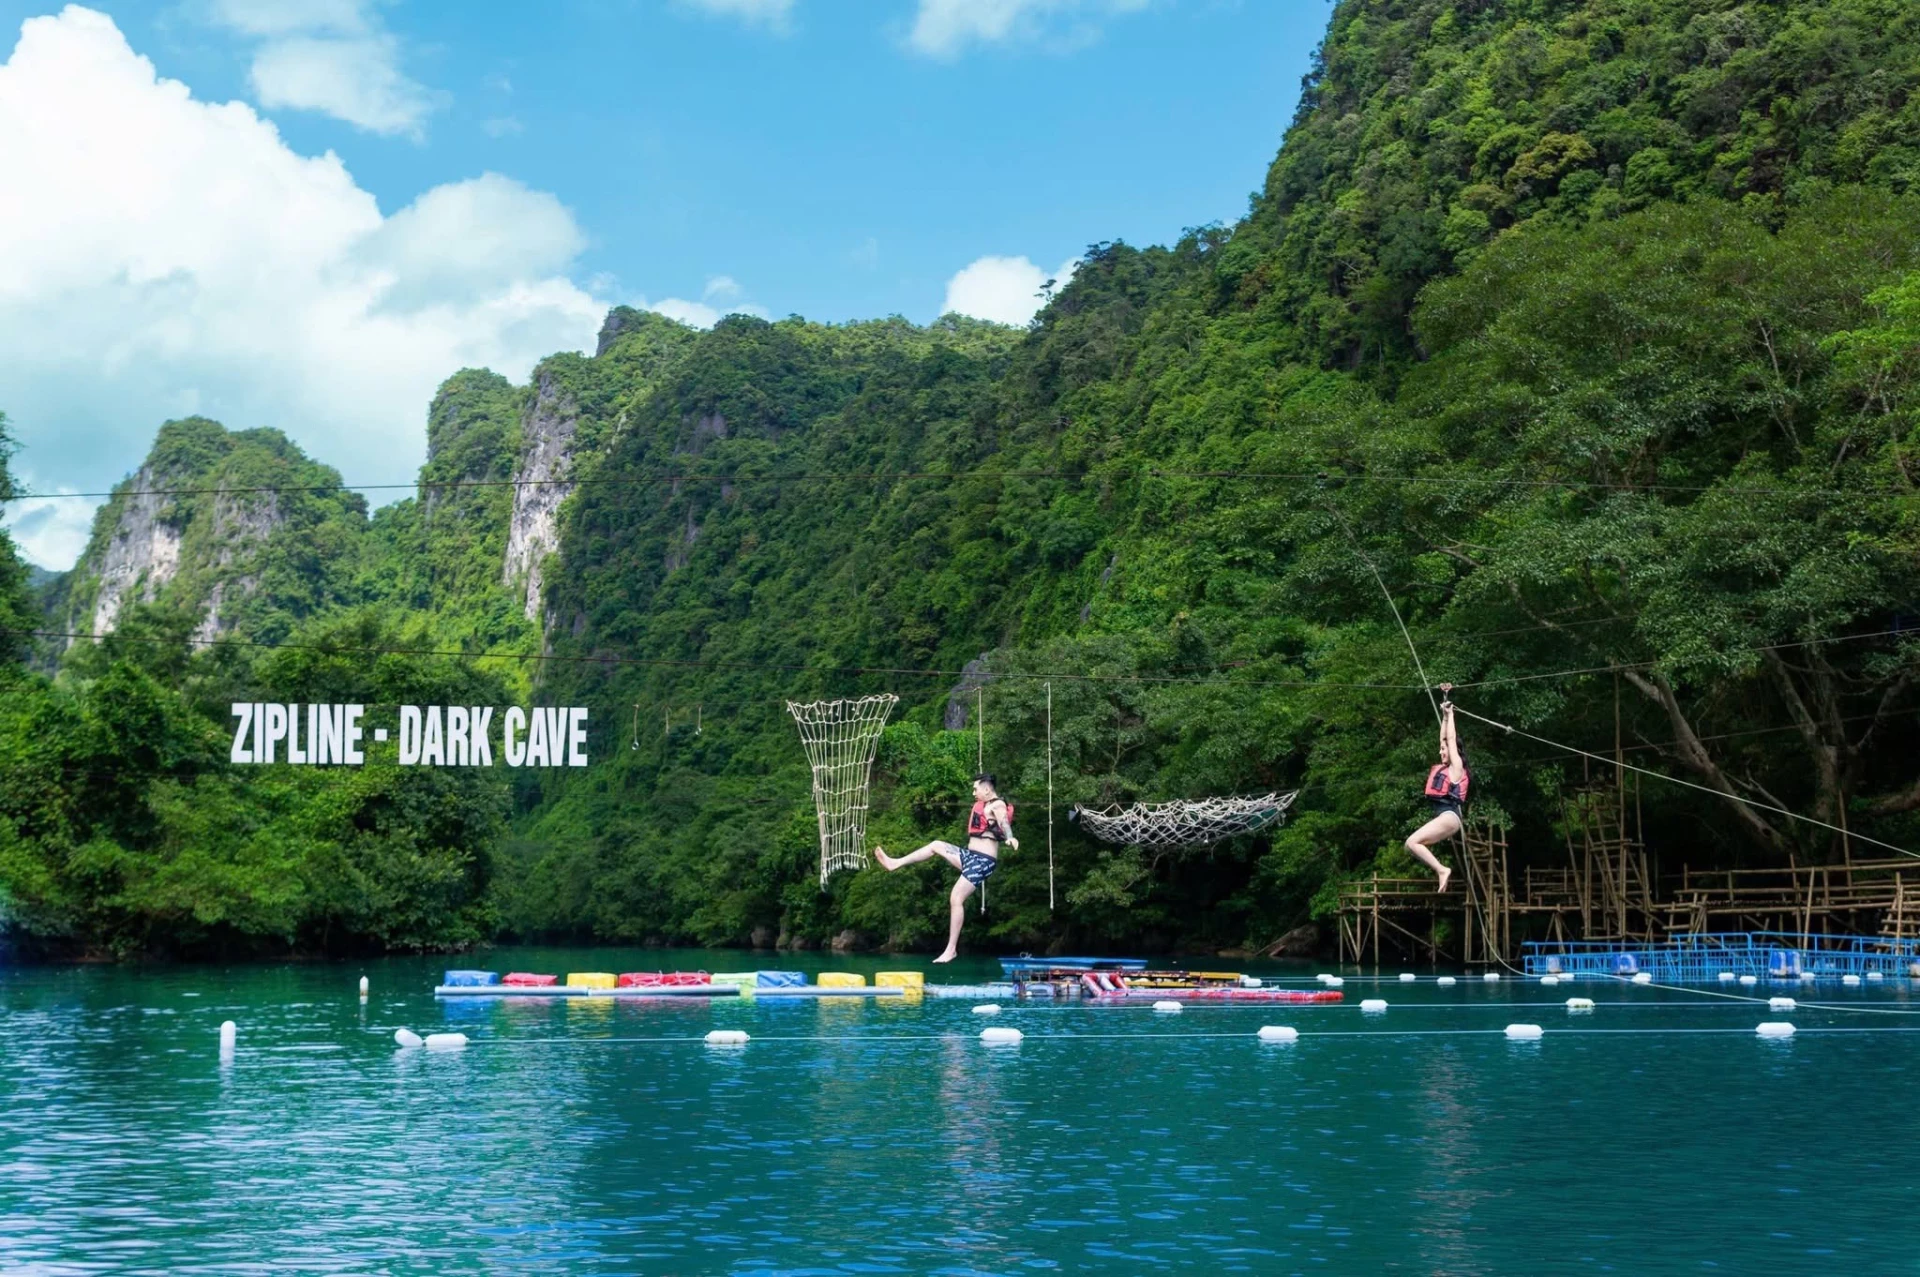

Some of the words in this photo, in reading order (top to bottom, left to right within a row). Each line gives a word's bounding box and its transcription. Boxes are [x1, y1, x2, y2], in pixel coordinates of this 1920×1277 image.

[231, 703, 364, 764] ZIPLINE
[399, 705, 494, 766] DARK
[504, 706, 588, 767] CAVE
